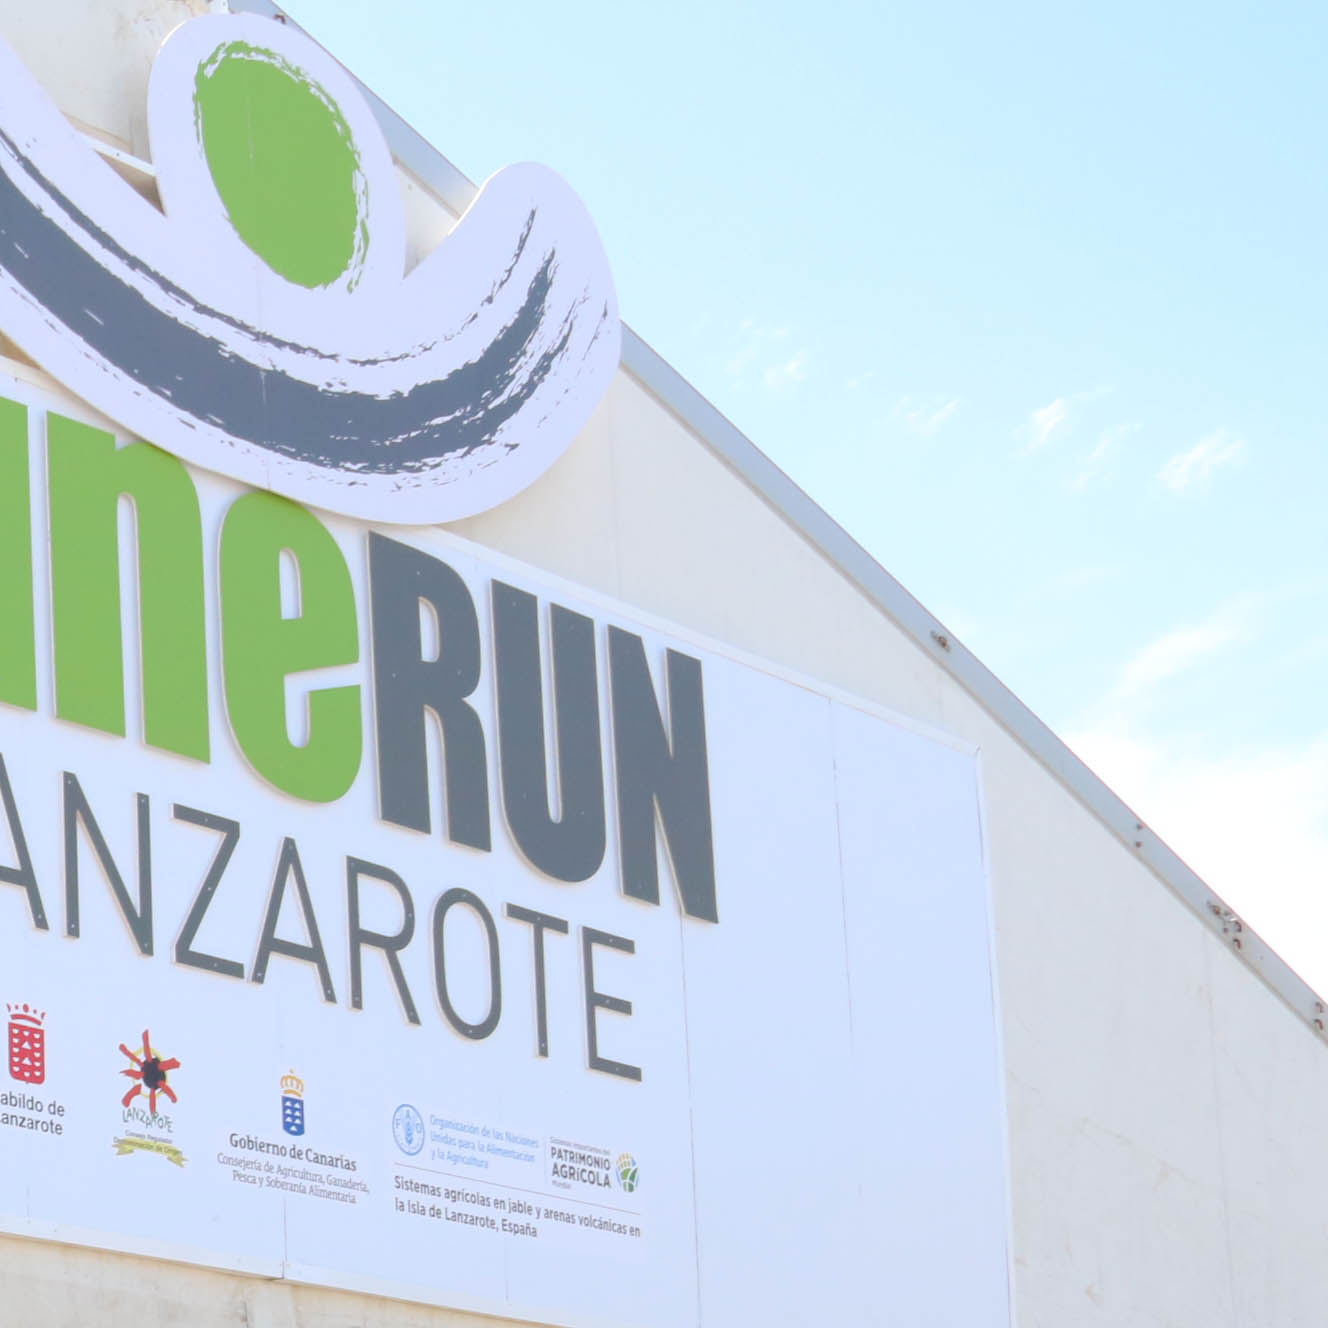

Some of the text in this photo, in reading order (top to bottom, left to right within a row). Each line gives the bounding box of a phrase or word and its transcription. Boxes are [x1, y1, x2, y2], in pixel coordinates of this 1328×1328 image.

[48, 1100, 65, 1117] de
[122, 1107, 174, 1134] LANZAROTE
[217, 1151, 262, 1172] Consejería
[263, 1160, 275, 1173] de
[229, 1133, 357, 1172] Gobierno de Canarias
[551, 1146, 611, 1171] PATRIMONIO
[233, 1169, 257, 1185] Pesca
[258, 1177, 264, 1188] y
[266, 1176, 307, 1195] Soberanía
[394, 1175, 641, 1238] Sistemas agrícolas en jable y arenas volcánicas en
[395, 1196, 538, 1238] la Isla de Lanzarote, España
